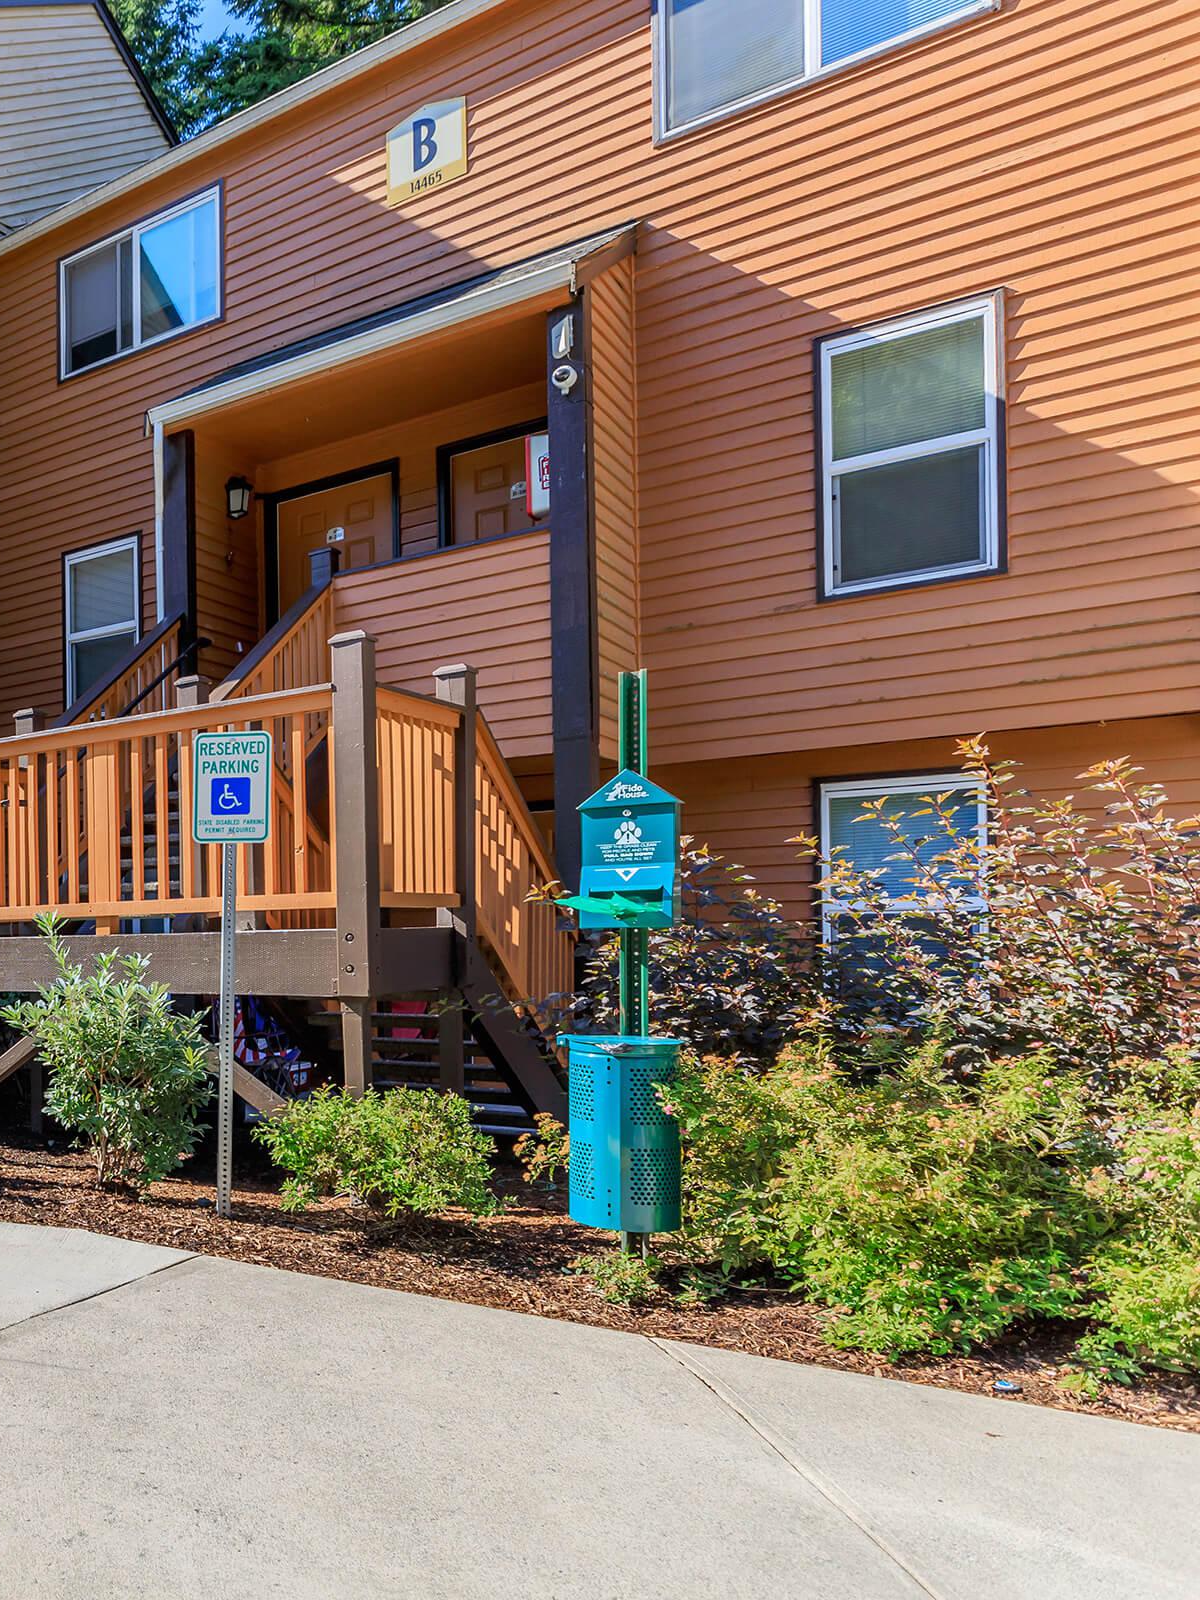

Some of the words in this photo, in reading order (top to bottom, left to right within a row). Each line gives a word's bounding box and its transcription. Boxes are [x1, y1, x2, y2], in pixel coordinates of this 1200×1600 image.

[412, 117, 438, 173] B
[410, 169, 442, 193] 14465
[200, 741, 265, 756] RESERVED
[202, 760, 259, 774] PARKING
[621, 783, 643, 792] Fido
